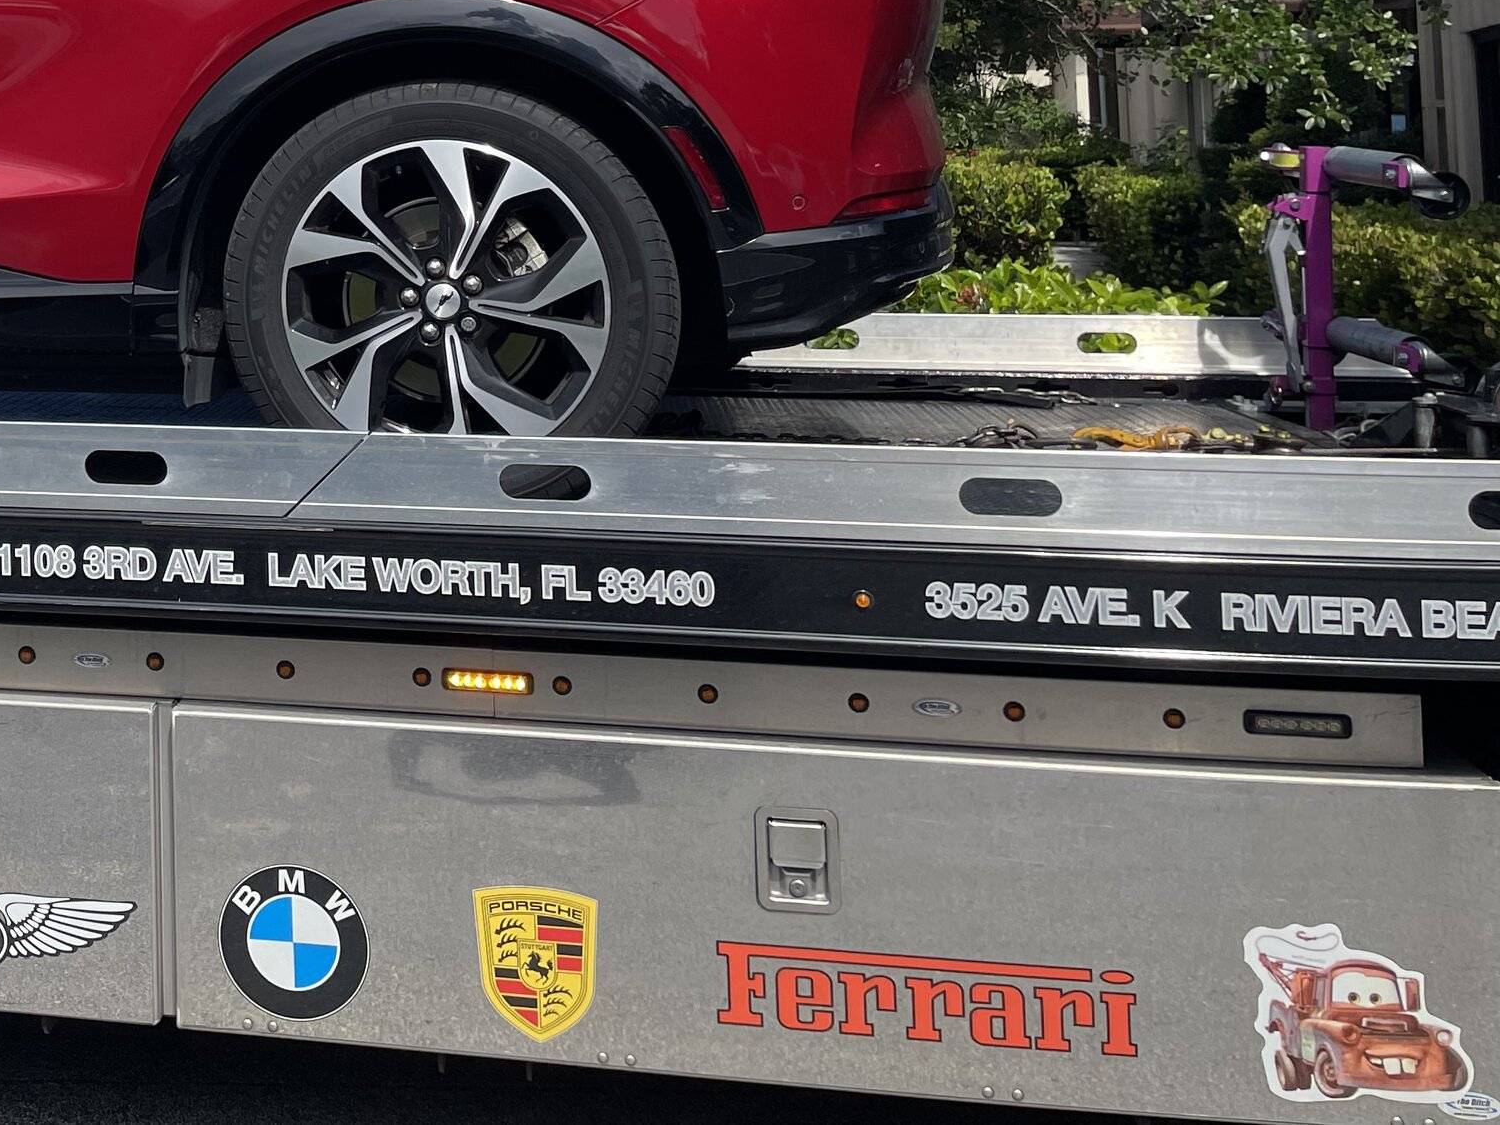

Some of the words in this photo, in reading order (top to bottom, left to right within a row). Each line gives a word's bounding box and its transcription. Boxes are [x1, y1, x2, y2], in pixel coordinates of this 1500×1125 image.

[82, 545, 158, 582] 3RD
[162, 549, 245, 586] AVE.
[267, 553, 367, 592] LAKE
[371, 557, 532, 606] WORTH,
[540, 564, 592, 602] FL
[597, 567, 716, 608] 33460
[924, 581, 1030, 622] 3525
[1037, 585, 1141, 627] AVE.
[1152, 590, 1192, 629] K
[1220, 592, 1413, 638] RIVIERA
[231, 869, 356, 922] BMW
[488, 901, 583, 921] PORSCHE
[716, 940, 1138, 1057] Ferrari
